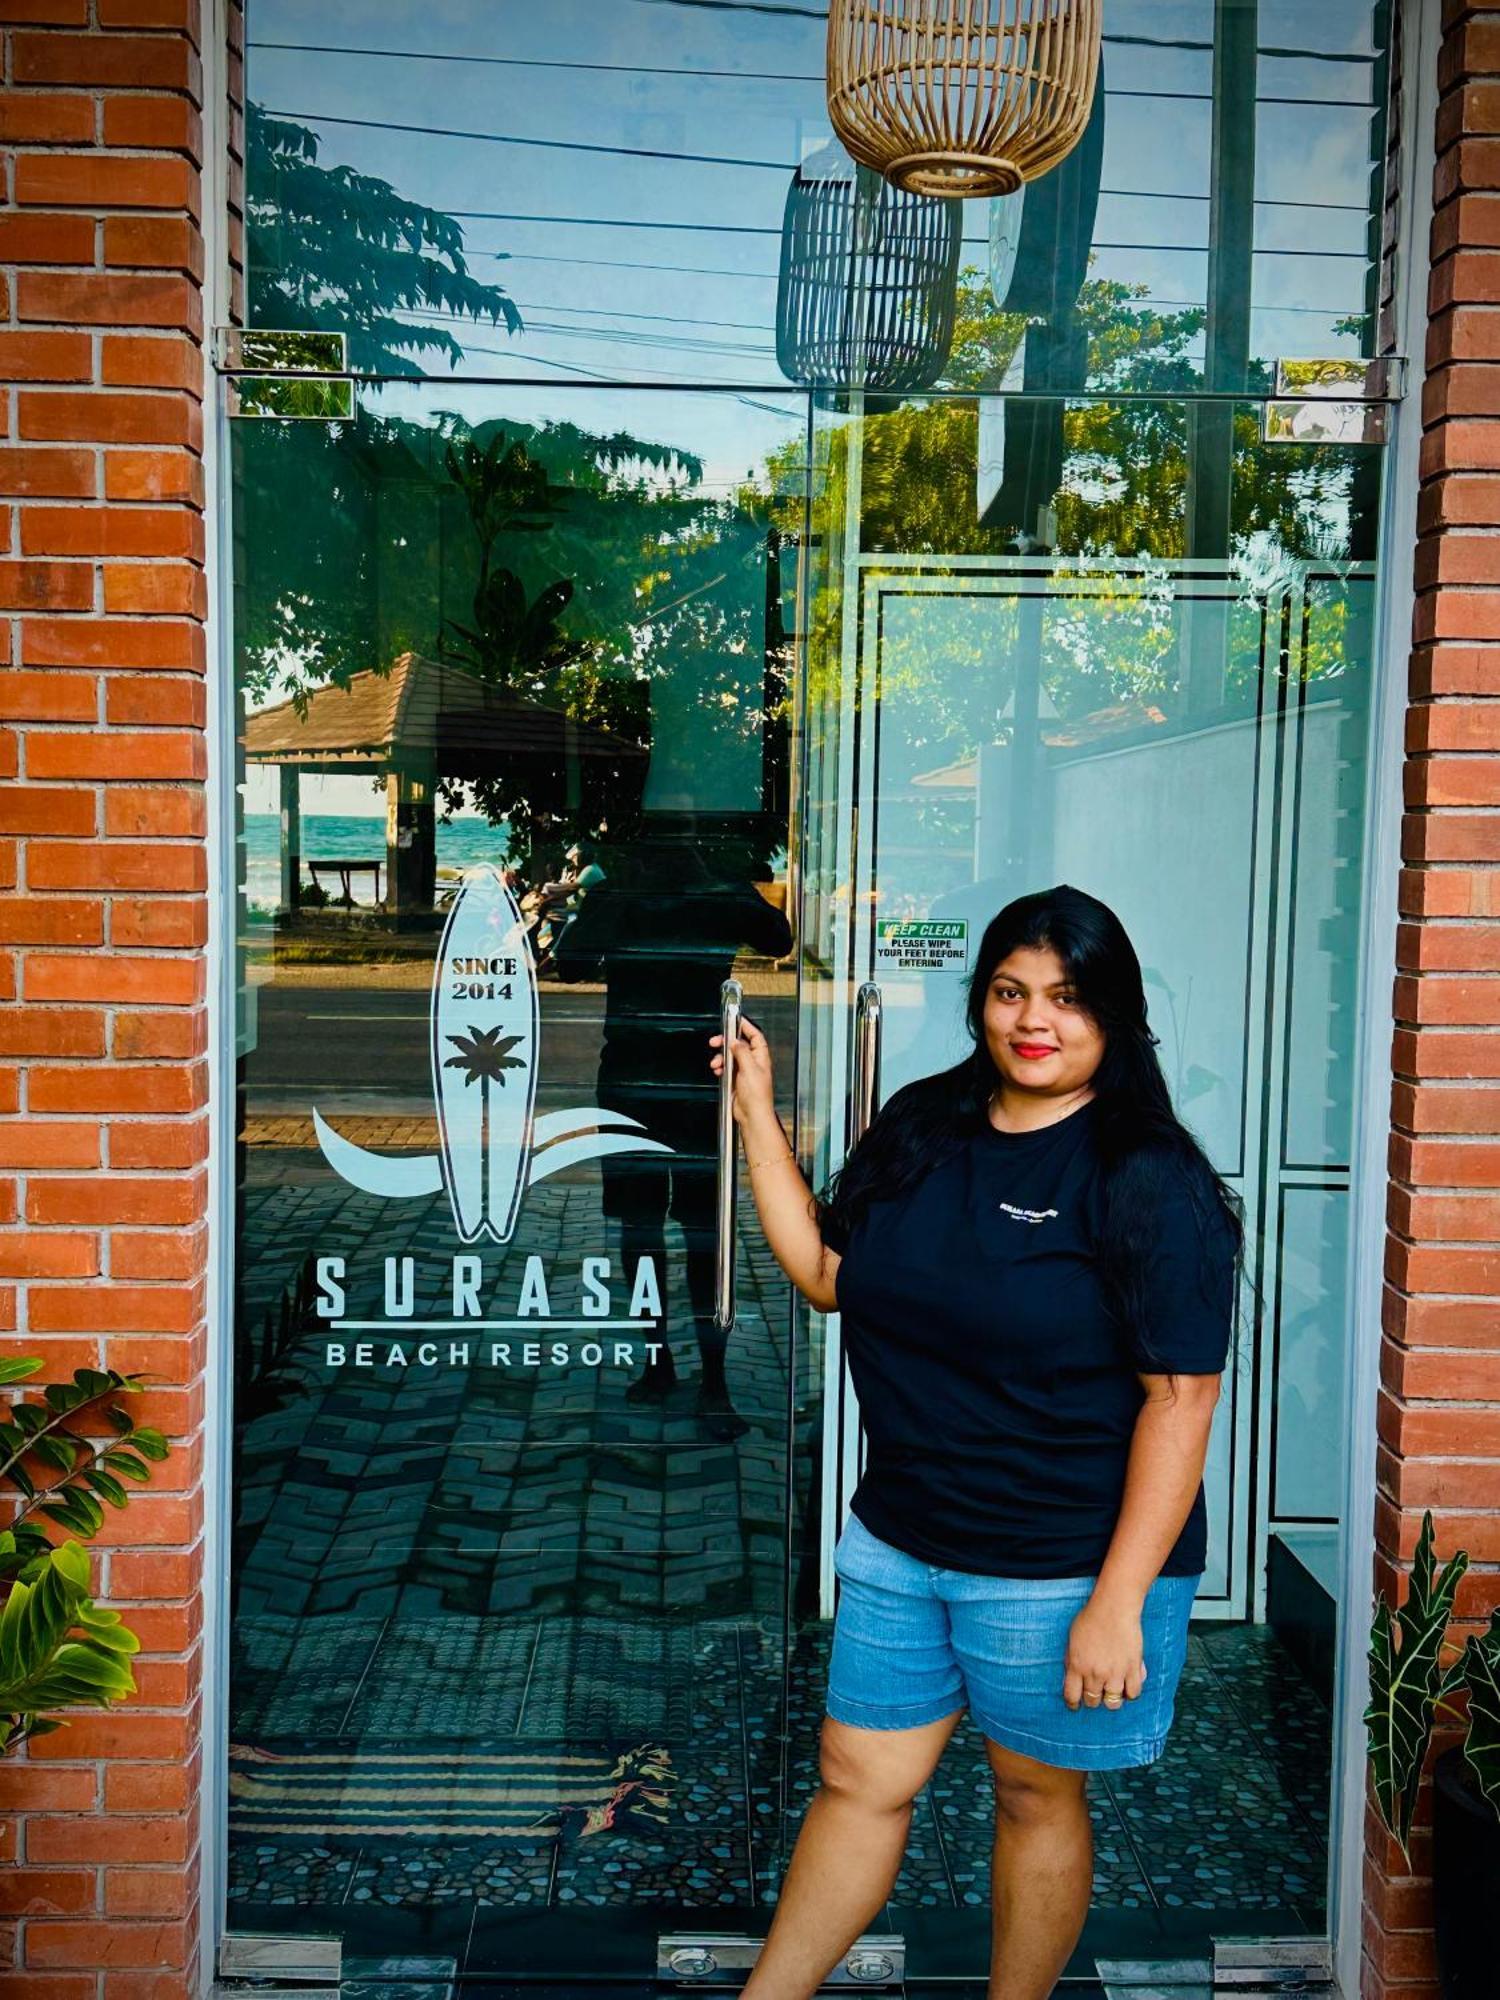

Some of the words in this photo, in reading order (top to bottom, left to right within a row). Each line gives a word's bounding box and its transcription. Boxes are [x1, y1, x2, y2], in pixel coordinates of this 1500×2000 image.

[883, 924, 917, 937] KEEP
[920, 924, 960, 937] CLEAN
[891, 939, 926, 948] PLEASE
[928, 939, 952, 949] WIPE
[878, 948, 903, 958] YOUR
[905, 948, 927, 958] FEET
[930, 949, 965, 959] BEFORE
[451, 957, 517, 976] SINCE
[899, 959, 943, 968] ENTERING
[451, 982, 513, 1000] 2014
[316, 1255, 663, 1318] SURASA
[326, 1342, 470, 1367] BEACH
[491, 1342, 663, 1367] RESORT
